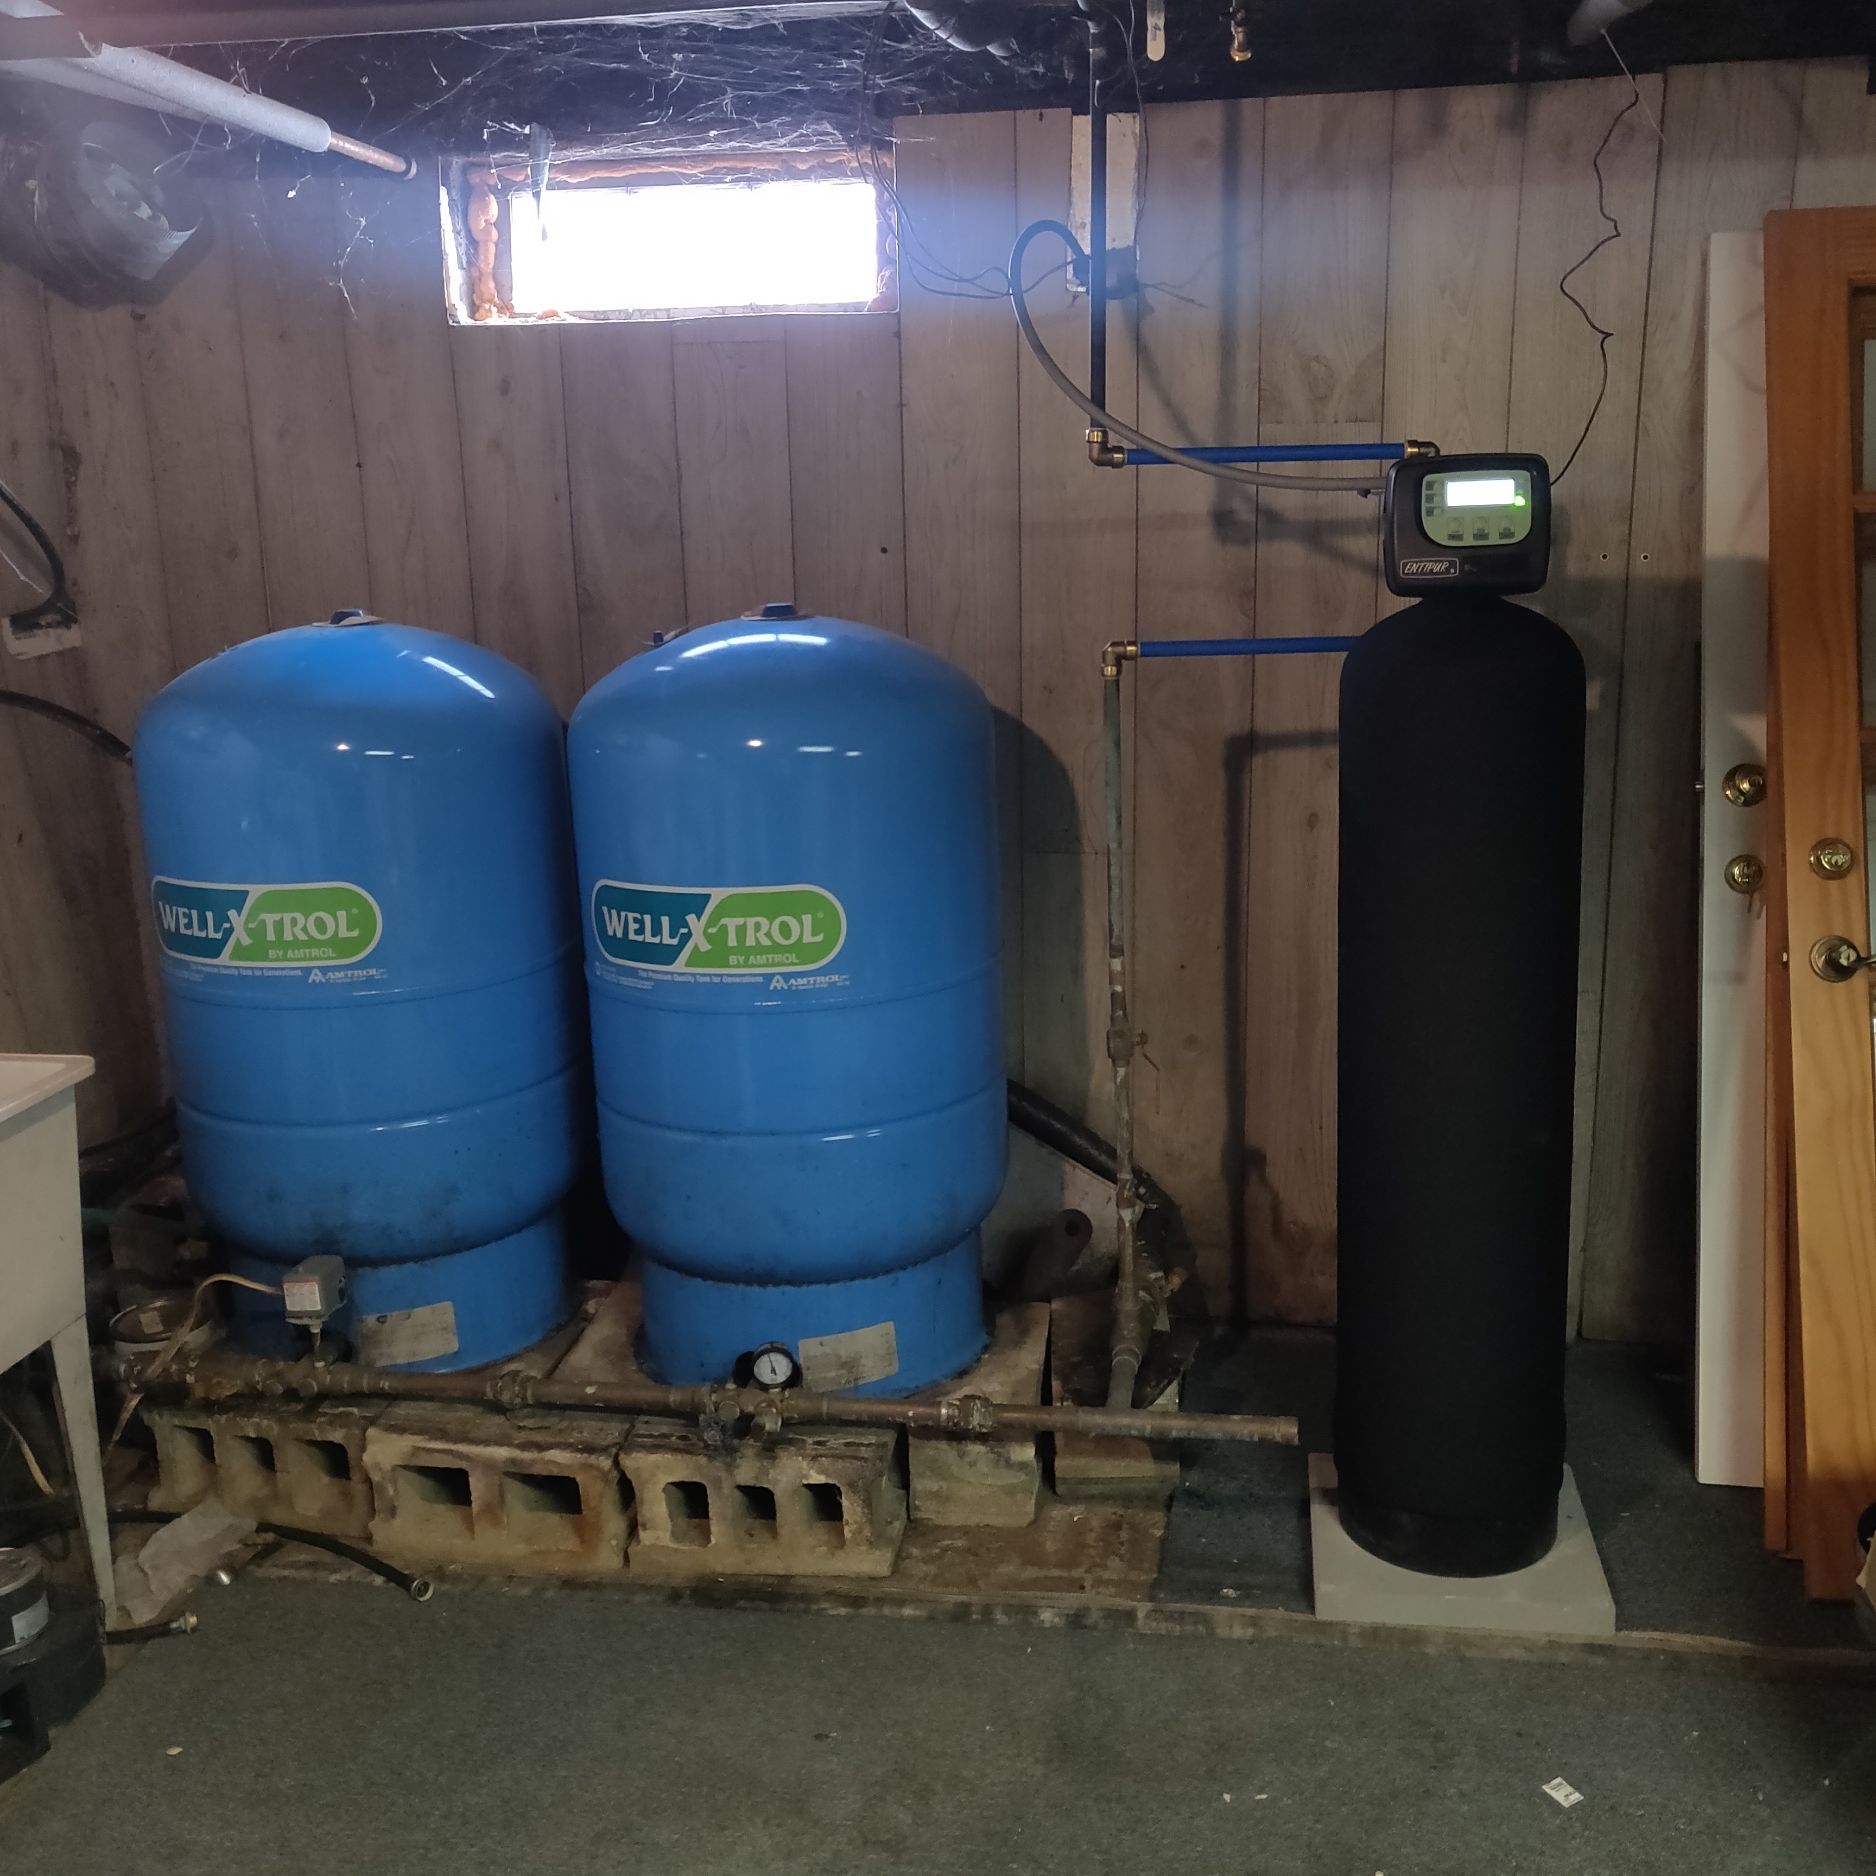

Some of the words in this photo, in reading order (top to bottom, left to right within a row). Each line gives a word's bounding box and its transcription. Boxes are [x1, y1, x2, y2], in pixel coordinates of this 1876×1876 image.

[1404, 561, 1449, 574] ENTIPUR
[268, 949, 283, 960] BY
[287, 948, 336, 959] AMTROL
[729, 955, 745, 965] BY
[748, 953, 799, 964] AMTROL
